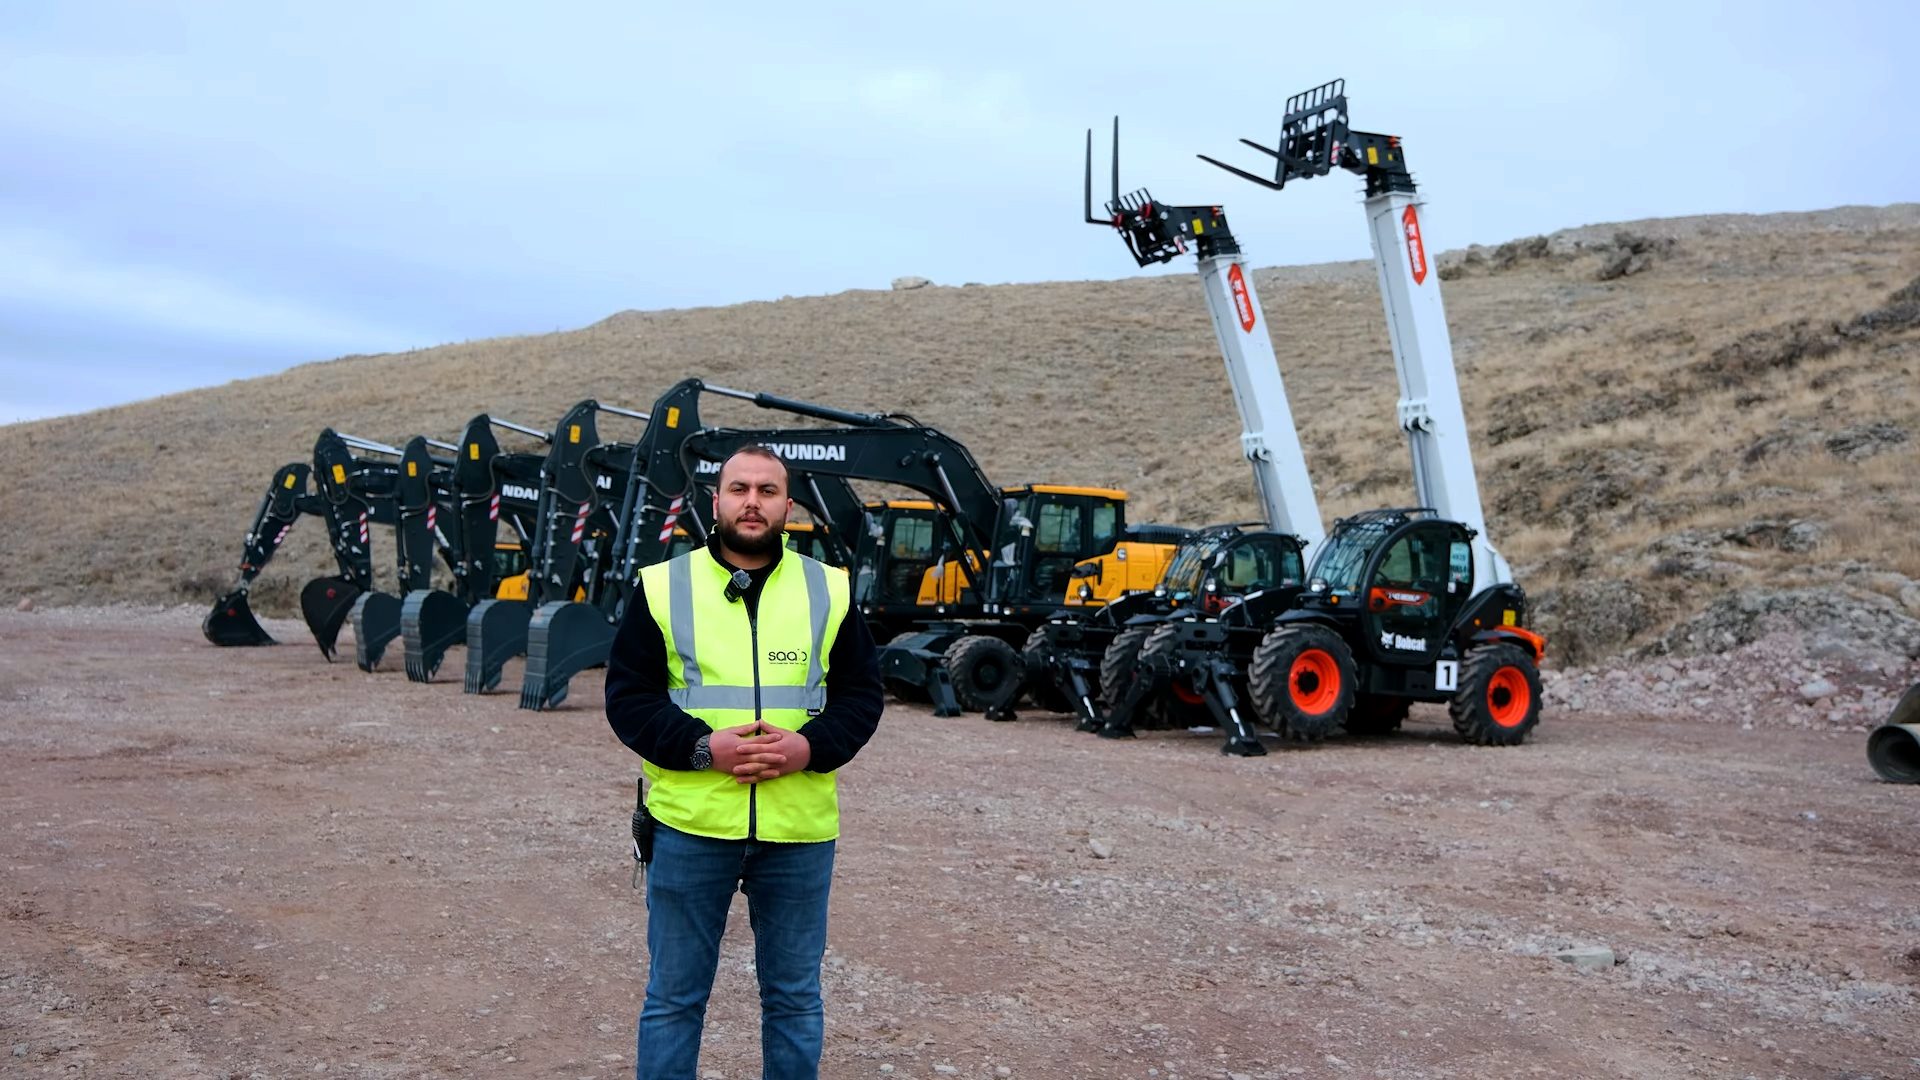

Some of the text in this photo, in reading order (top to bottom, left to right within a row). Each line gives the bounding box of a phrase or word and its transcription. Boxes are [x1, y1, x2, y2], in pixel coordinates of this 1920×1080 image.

[757, 442, 846, 462] YUNDAI
[501, 484, 540, 501] NDAI
[1395, 634, 1427, 652] Bobcat
[1444, 665, 1451, 687] 1
